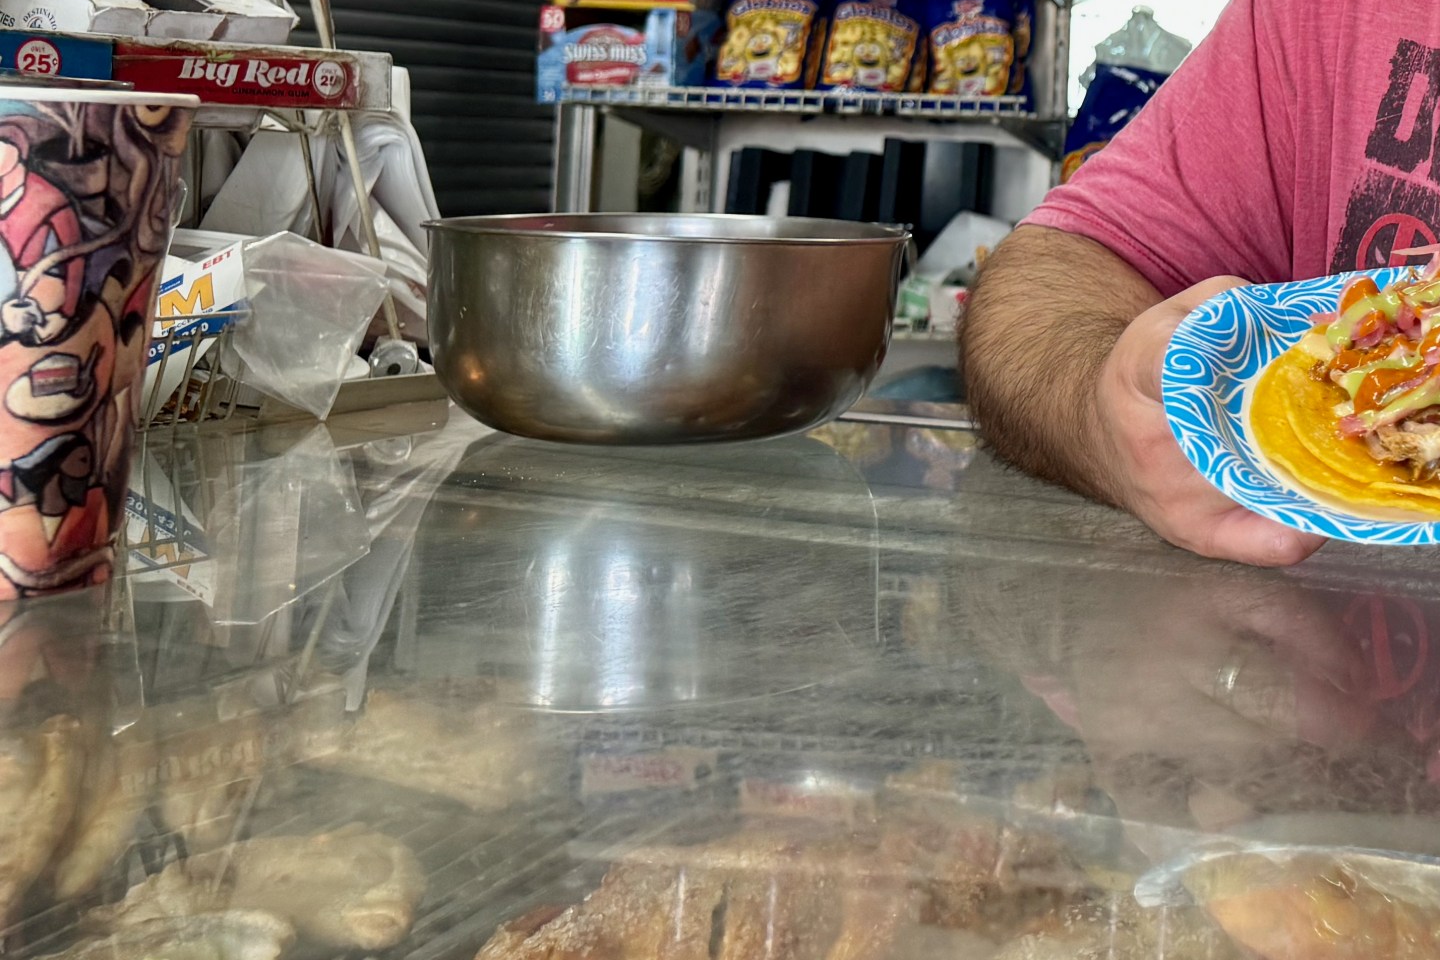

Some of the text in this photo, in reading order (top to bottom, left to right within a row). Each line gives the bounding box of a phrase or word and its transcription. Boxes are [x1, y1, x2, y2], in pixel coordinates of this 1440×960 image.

[178, 57, 310, 88] Big Red
[287, 90, 311, 98] GUM
[202, 248, 234, 271] EBT
